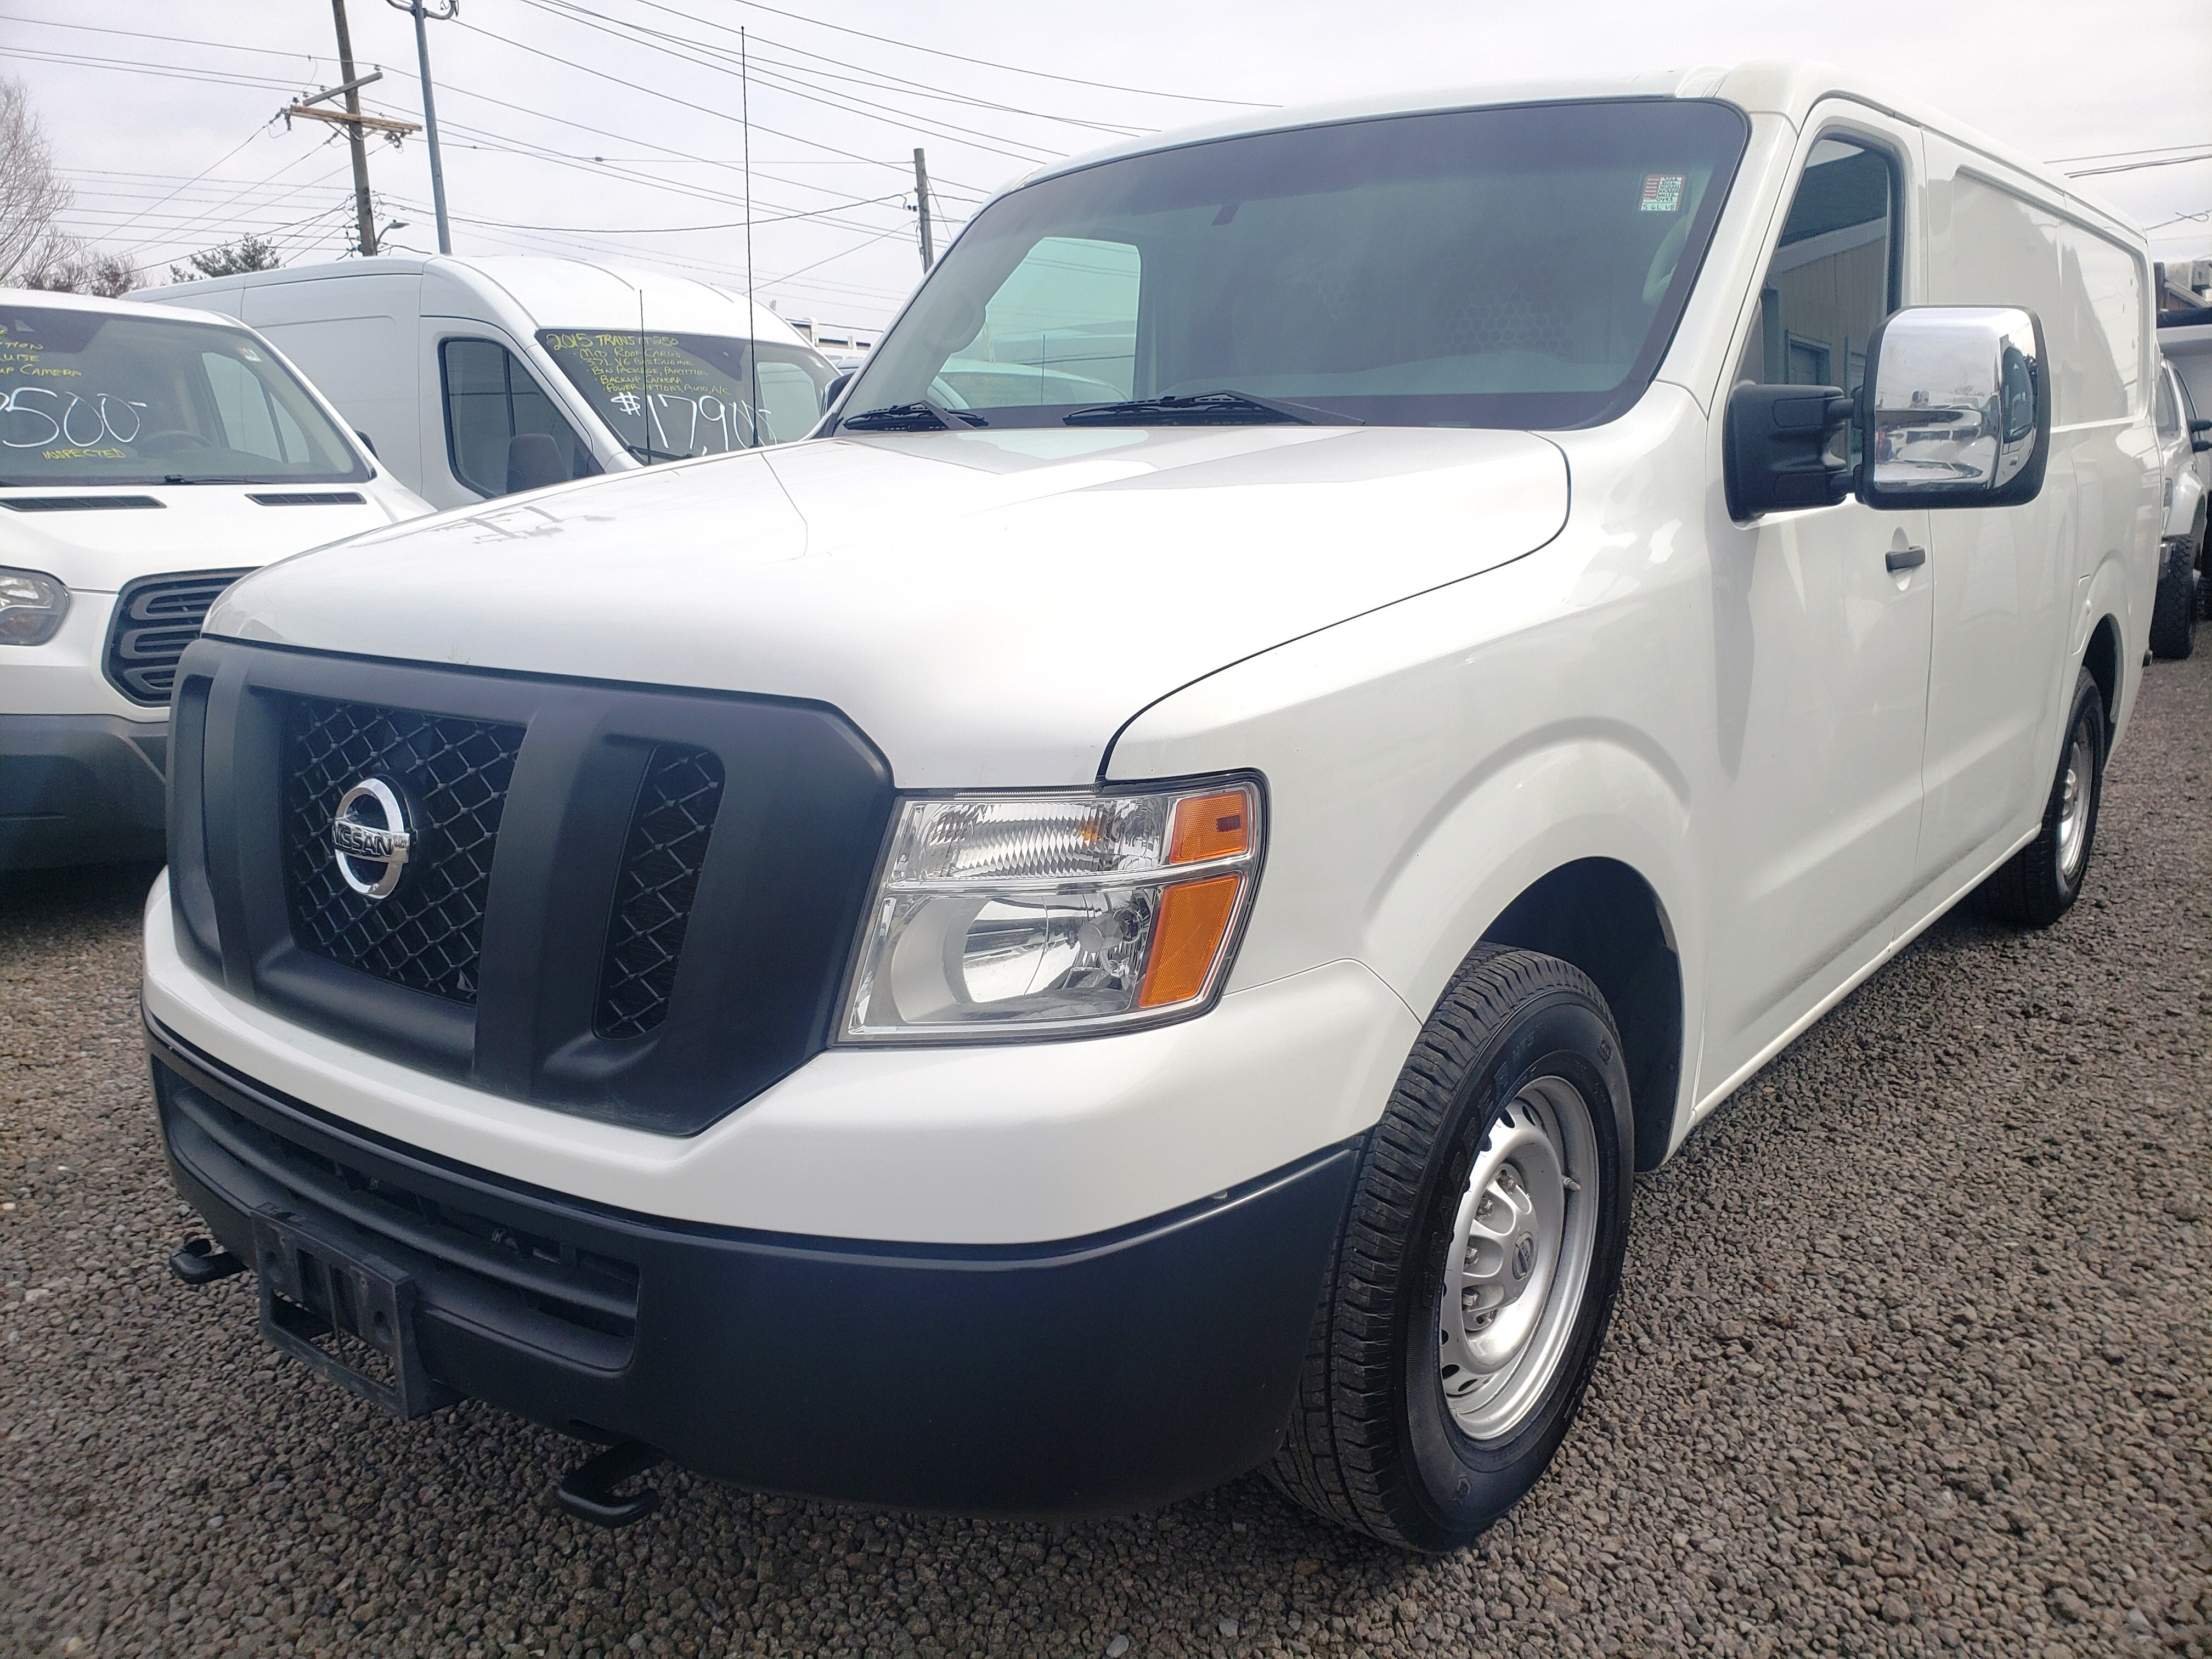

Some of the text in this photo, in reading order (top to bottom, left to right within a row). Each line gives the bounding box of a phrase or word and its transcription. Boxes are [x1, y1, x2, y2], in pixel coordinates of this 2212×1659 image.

[546, 333, 679, 351] 2015 TRANSIT 250
[645, 348, 681, 358] CARGO
[614, 358, 631, 366] V6
[20, 363, 81, 377] CAMERA
[600, 374, 682, 385] BACKUP CAMERA
[606, 383, 644, 393] POWER
[42, 447, 126, 460] INSPECTED
[332, 822, 393, 857] NISSAN
